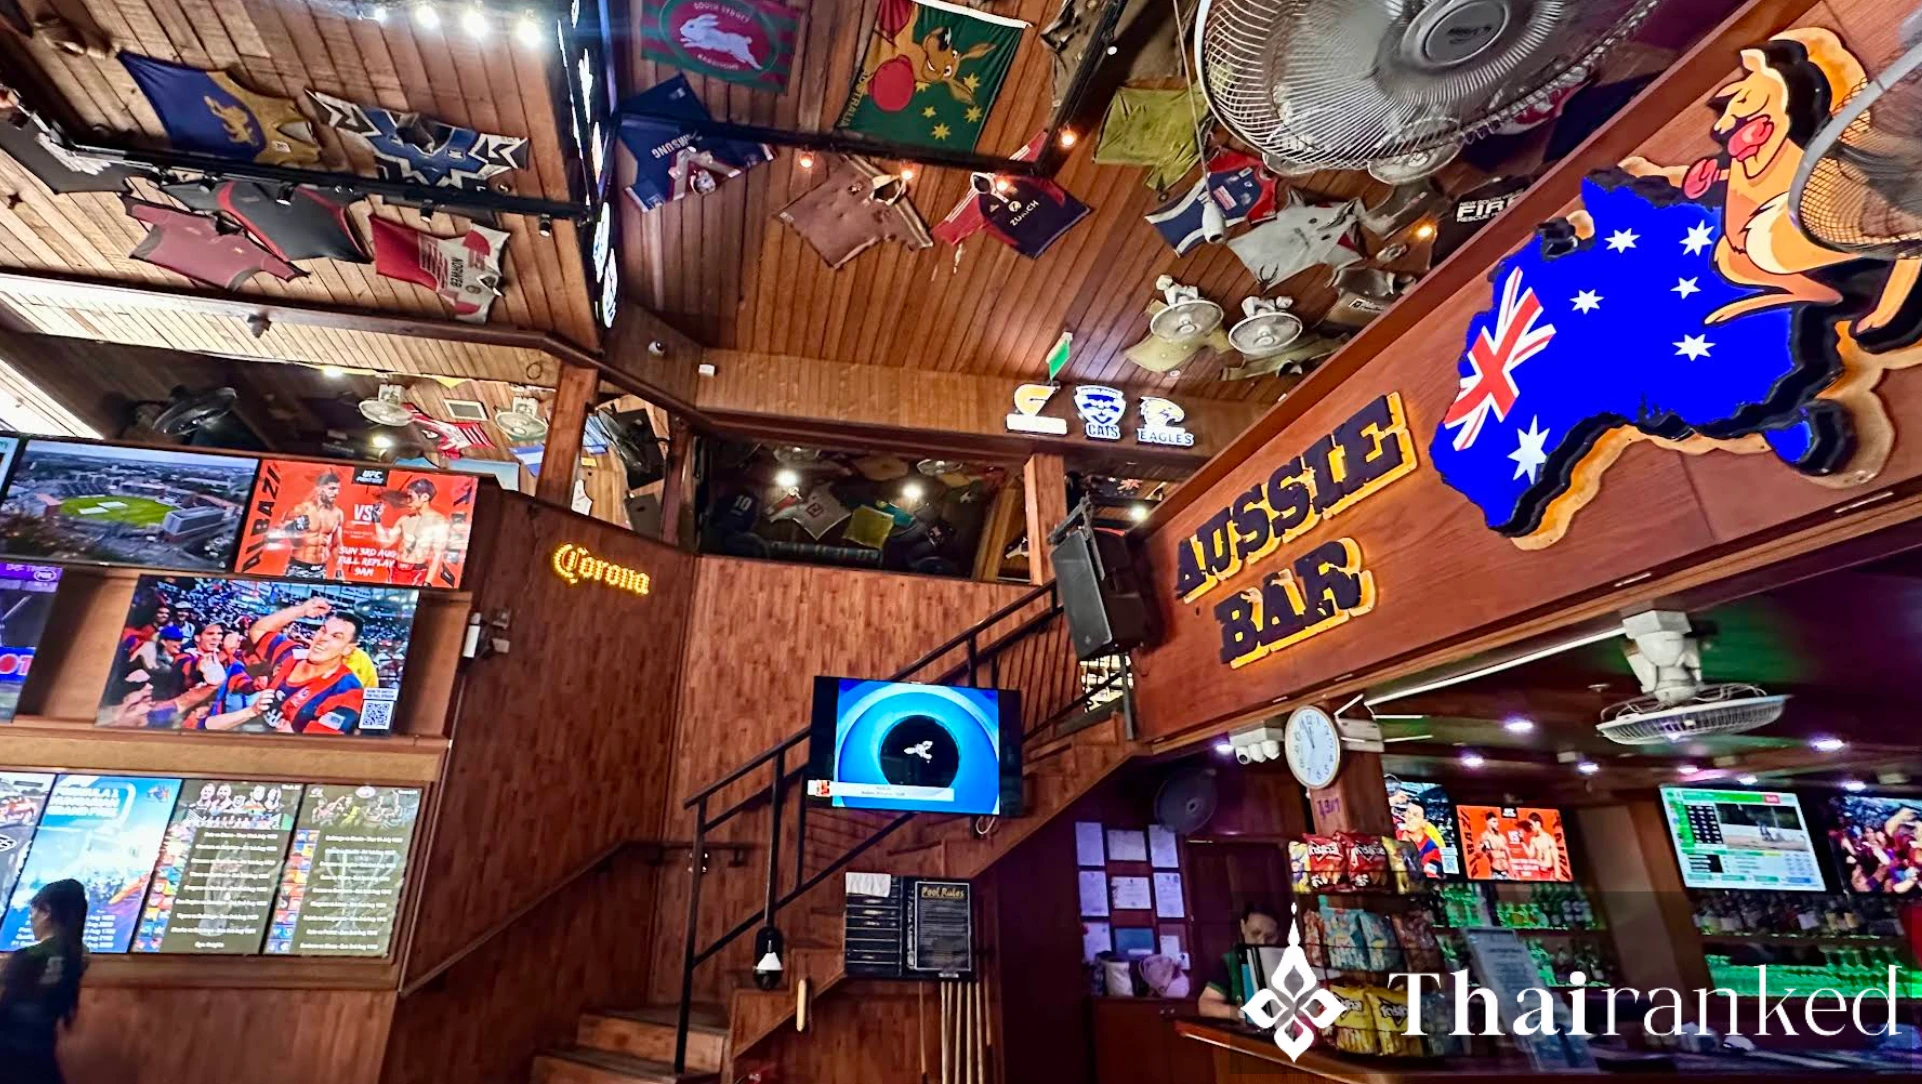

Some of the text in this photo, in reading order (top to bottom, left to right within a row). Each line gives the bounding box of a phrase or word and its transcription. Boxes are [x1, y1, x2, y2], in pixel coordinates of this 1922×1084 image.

[1087, 424, 1118, 438] CATS
[1140, 430, 1193, 445] EAGLES
[362, 470, 383, 479] UFC
[1176, 391, 1418, 604] AUSSIE
[354, 504, 373, 520] VS
[339, 546, 358, 556] SUN
[359, 547, 377, 557] 3RD
[361, 557, 395, 568] REPLAY
[553, 543, 650, 595] Corona
[1214, 538, 1376, 669] BAR
